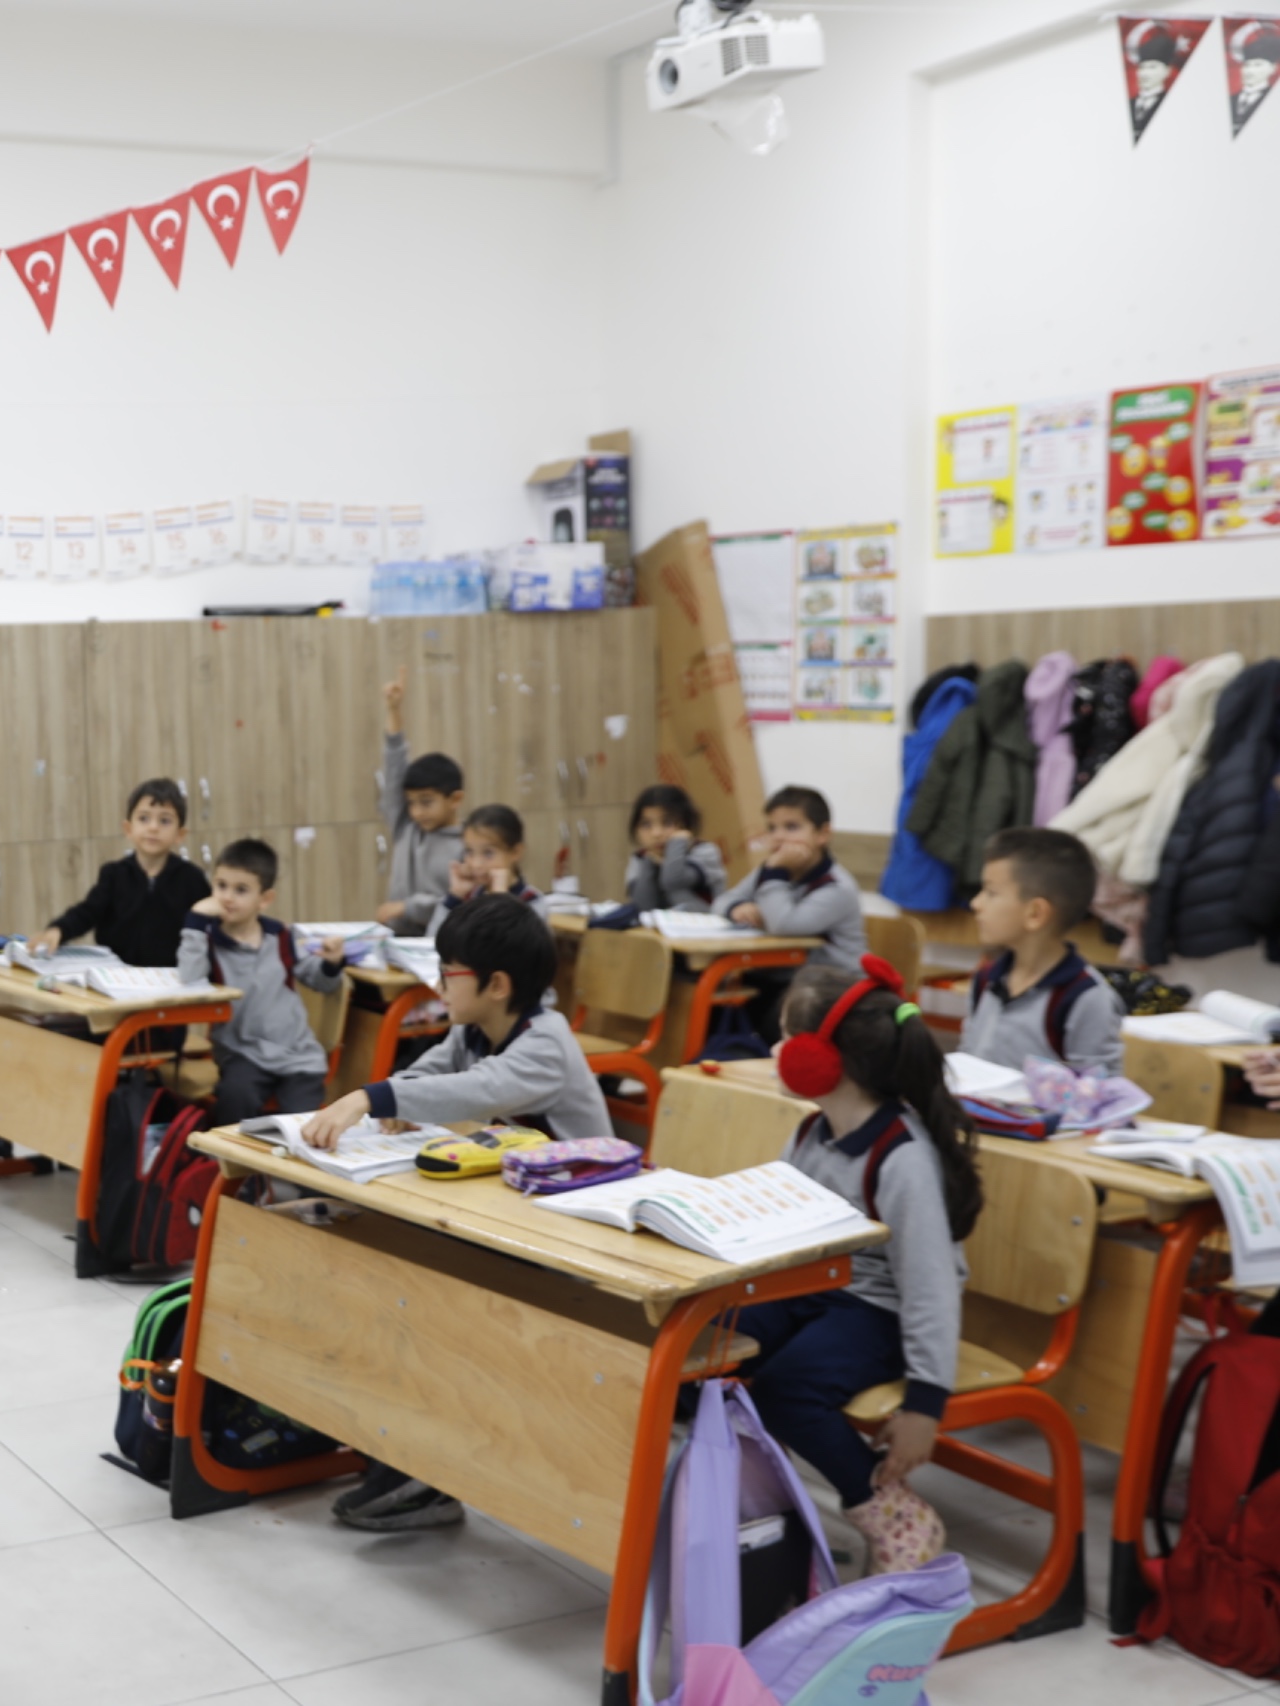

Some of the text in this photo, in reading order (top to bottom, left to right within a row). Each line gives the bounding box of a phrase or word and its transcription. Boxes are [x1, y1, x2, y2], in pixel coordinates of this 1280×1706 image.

[14, 541, 34, 561] 12
[67, 541, 86, 561] 13
[117, 538, 137, 556] 14
[166, 531, 187, 551] 15
